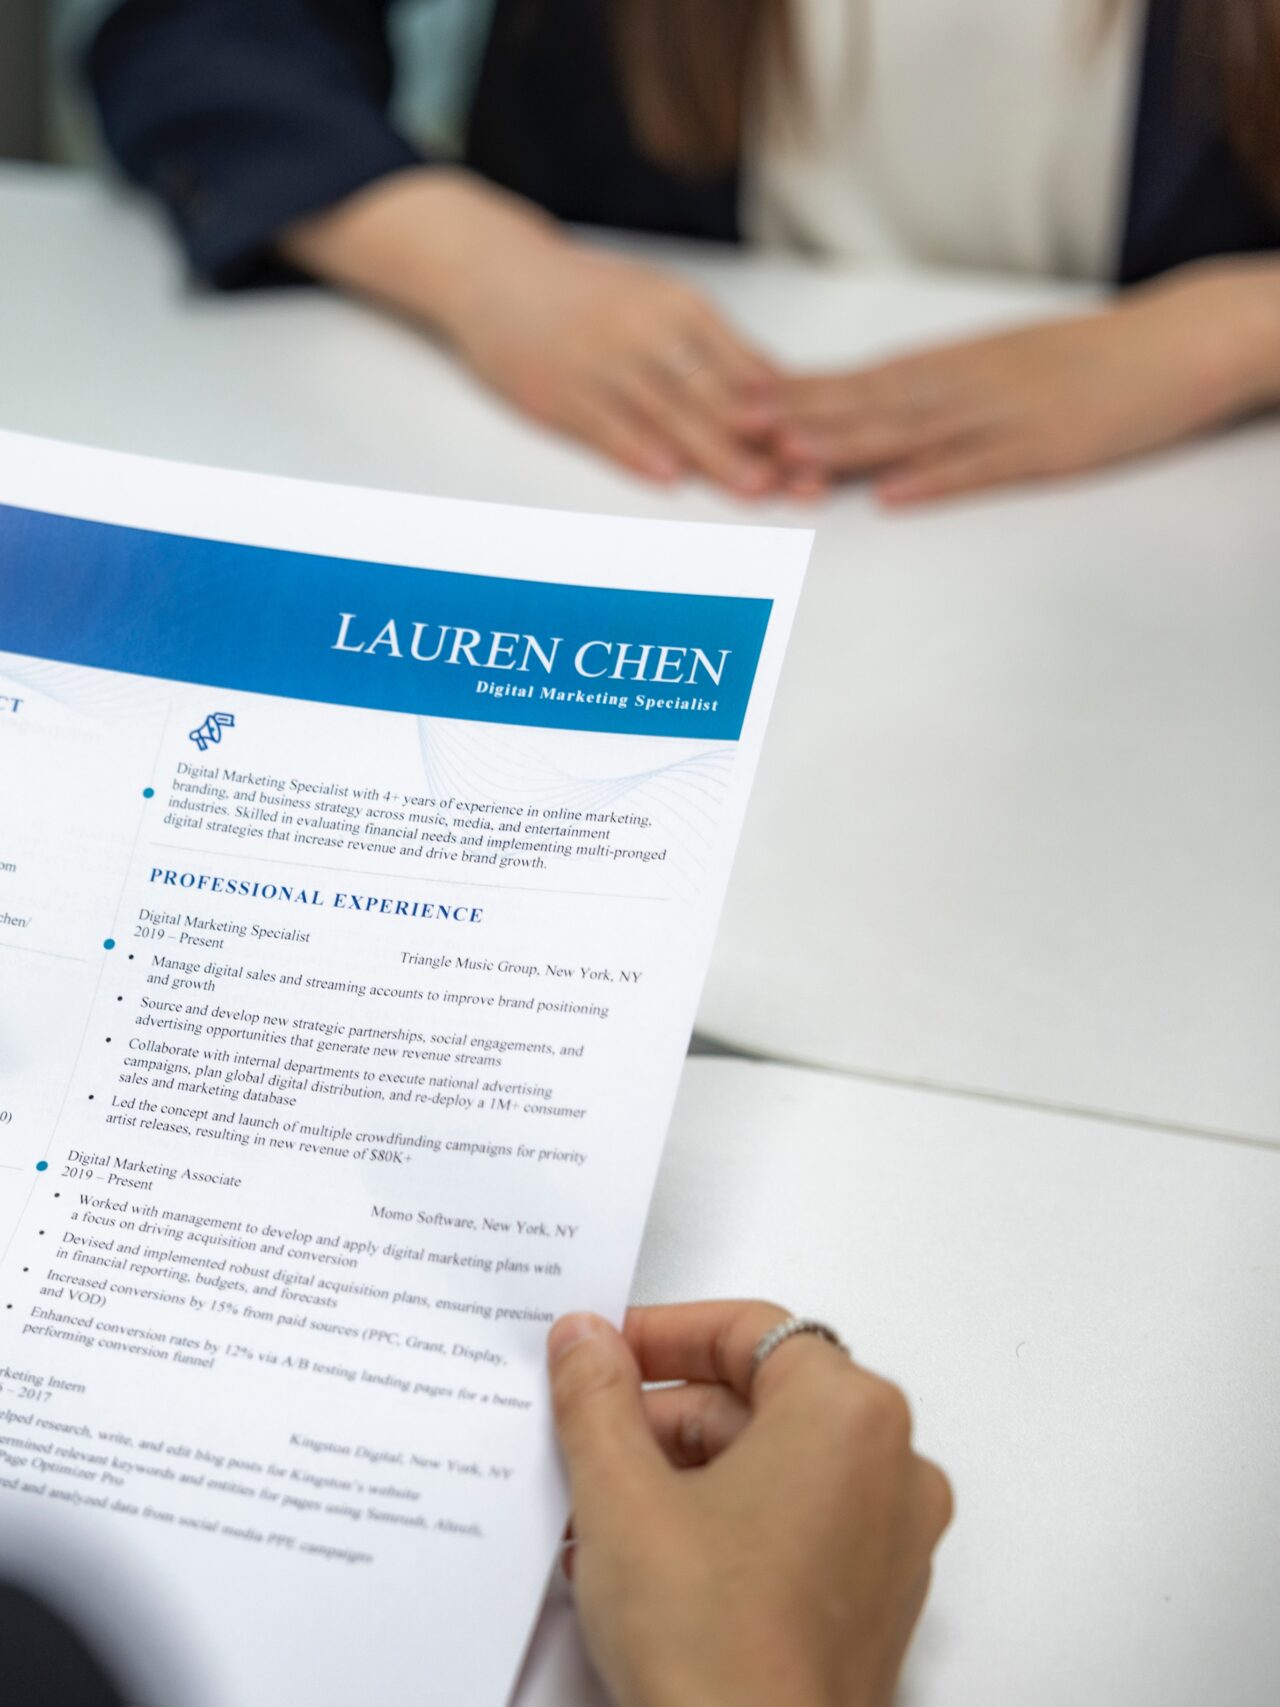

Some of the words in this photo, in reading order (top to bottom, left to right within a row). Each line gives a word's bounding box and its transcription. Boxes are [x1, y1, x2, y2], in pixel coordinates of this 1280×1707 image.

[331, 612, 563, 673] LAUREN
[574, 640, 731, 685] CHEN
[475, 680, 534, 697] Digital
[539, 686, 628, 708] Marketing
[634, 694, 717, 711] Specialist
[171, 777, 229, 800] branding,
[232, 790, 256, 802] and
[258, 791, 311, 809] business
[313, 801, 363, 818] strategy
[365, 808, 405, 820] across
[408, 812, 448, 827] music,
[452, 817, 493, 830] media,
[497, 820, 521, 832] and
[524, 824, 610, 839] entertainment
[176, 761, 219, 779] Digital
[222, 768, 285, 791] Marketing
[288, 778, 348, 797] Specialist
[352, 787, 379, 800] with
[382, 791, 398, 802] 4+
[401, 795, 435, 807] years
[439, 797, 455, 808] of
[455, 801, 523, 816] experience
[526, 804, 539, 817] in
[542, 807, 582, 820] online
[585, 811, 651, 828] marketing,
[163, 812, 203, 829] digital
[205, 821, 263, 838] strategies
[266, 827, 290, 841] that
[293, 830, 344, 848] increase
[347, 840, 396, 854] revenue
[399, 845, 423, 857] and
[425, 846, 457, 860] drive
[461, 849, 497, 864] brand
[498, 856, 546, 868] growth.
[167, 795, 229, 815] industries.
[234, 805, 278, 822] Skilled
[280, 811, 293, 824] in
[296, 816, 360, 835] evaluating
[364, 822, 418, 839] financial
[420, 831, 456, 843] needs
[459, 834, 483, 846] and
[486, 835, 572, 856] implementing
[575, 844, 666, 862] multi-pronged
[149, 868, 323, 905] PROFESSIONAL
[333, 893, 483, 922] EXPERIENCE
[133, 925, 165, 939] 2019
[179, 931, 224, 948] Present
[138, 908, 181, 925] Digital
[184, 915, 247, 937] Marketing
[250, 924, 310, 942] Specialist
[146, 973, 170, 985] and
[170, 978, 215, 991] growth
[400, 951, 452, 969] Triangle
[455, 956, 493, 970] Music
[497, 960, 540, 977] Group,
[545, 964, 571, 976] New
[580, 966, 613, 982] York,
[619, 970, 642, 983] NY
[151, 954, 200, 974] Manage
[203, 962, 243, 978] digital
[245, 968, 276, 982] sales
[279, 973, 302, 985] and
[304, 977, 366, 997] streaming
[369, 986, 423, 999] accounts
[427, 991, 439, 1000] to
[442, 990, 494, 1006] improve
[497, 994, 534, 1009] brand
[536, 1000, 609, 1019] positioning
[118, 1072, 148, 1085] sales
[151, 1077, 175, 1089] and
[176, 1081, 239, 1101] marketing
[242, 1088, 296, 1106] database
[60, 1165, 93, 1179] 2019
[107, 1172, 152, 1190] Present
[67, 1149, 111, 1166] Digital
[113, 1156, 177, 1180] Marketing
[180, 1168, 241, 1187] Associate
[370, 1204, 413, 1221] Momo
[416, 1210, 476, 1230] Software,
[481, 1217, 510, 1232] New
[516, 1220, 549, 1237] York,
[554, 1223, 578, 1238] NY
[55, 1246, 68, 1259] in
[71, 1249, 128, 1269] financial
[128, 1261, 190, 1283] reporting,
[195, 1271, 247, 1293] budgets,
[251, 1285, 278, 1297] and
[280, 1284, 337, 1308] forecasts
[39, 1286, 64, 1298] and
[69, 1288, 106, 1307] VOD)
[21, 1323, 95, 1347] performing
[97, 1338, 169, 1360] conversion
[172, 1349, 215, 1368] funnel
[17, 1384, 52, 1402] 2017
[47, 1375, 86, 1393] Intern
